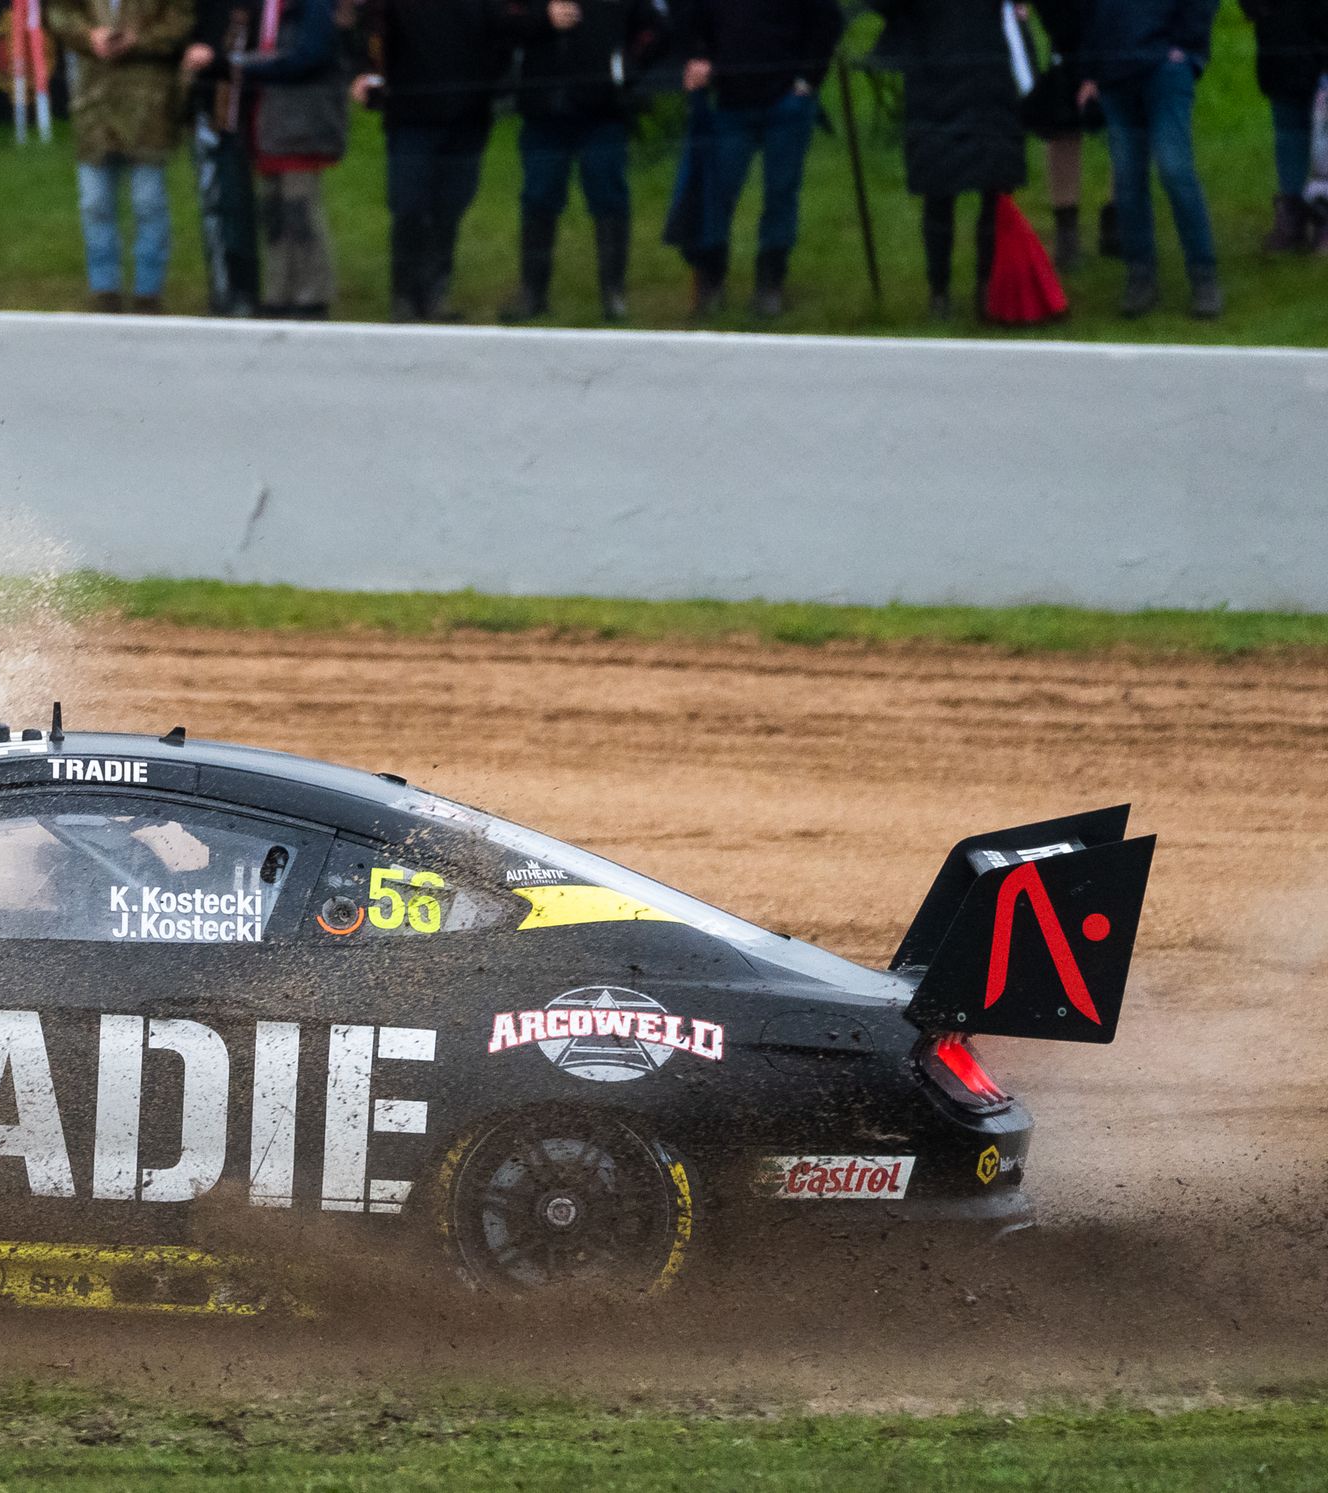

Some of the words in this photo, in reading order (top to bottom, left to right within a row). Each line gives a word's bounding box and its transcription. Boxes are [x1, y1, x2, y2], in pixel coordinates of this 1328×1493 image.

[47, 758, 148, 783] TRADIE
[506, 868, 569, 882] AUTHENTIC
[367, 867, 446, 934] 56
[487, 1008, 725, 1062] ARCOWELD
[787, 1159, 902, 1194] Castrol
